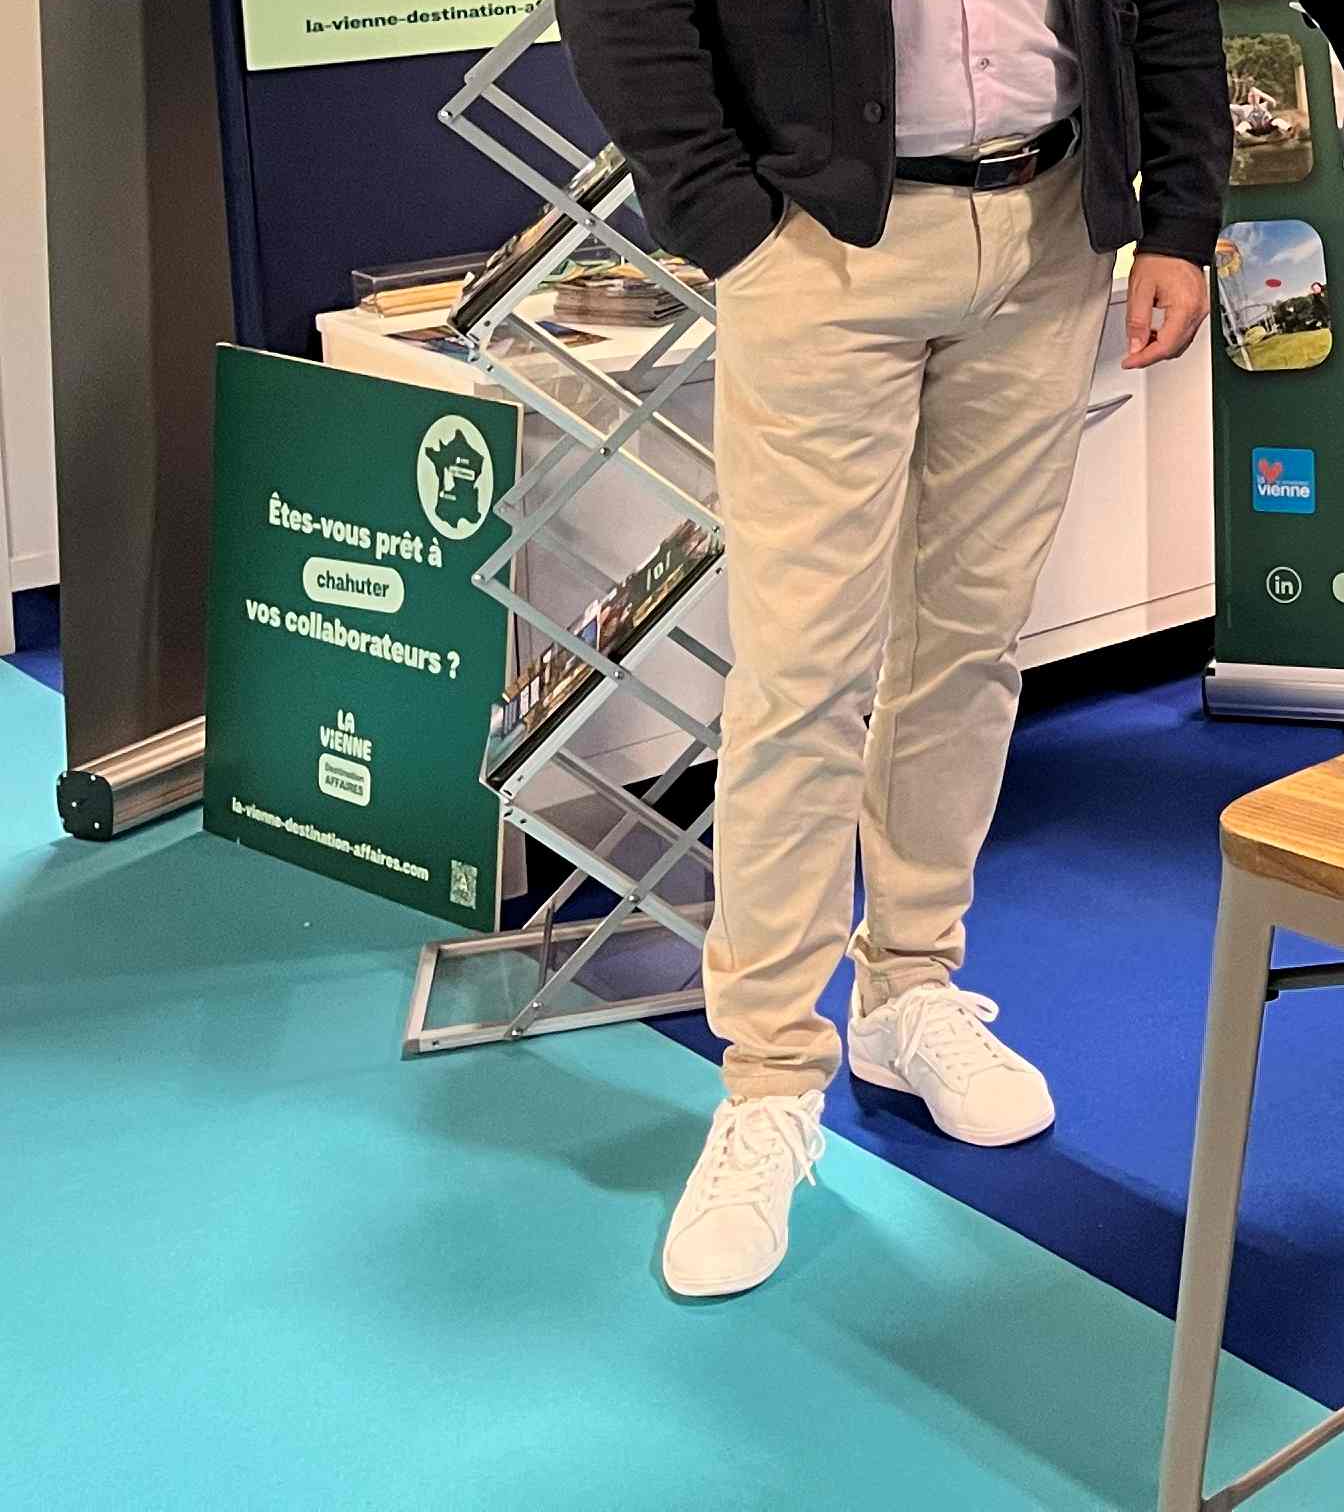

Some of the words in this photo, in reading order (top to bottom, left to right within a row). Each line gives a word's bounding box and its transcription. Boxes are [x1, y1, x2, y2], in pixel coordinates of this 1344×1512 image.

[268, 491, 372, 549] Êtes-vous
[375, 530, 423, 563] prêt
[427, 537, 443, 568] à
[317, 570, 390, 598] chahuter
[245, 599, 281, 628] vos
[284, 611, 442, 674] collaborateurs
[447, 650, 461, 679] ?
[337, 708, 355, 734] LA
